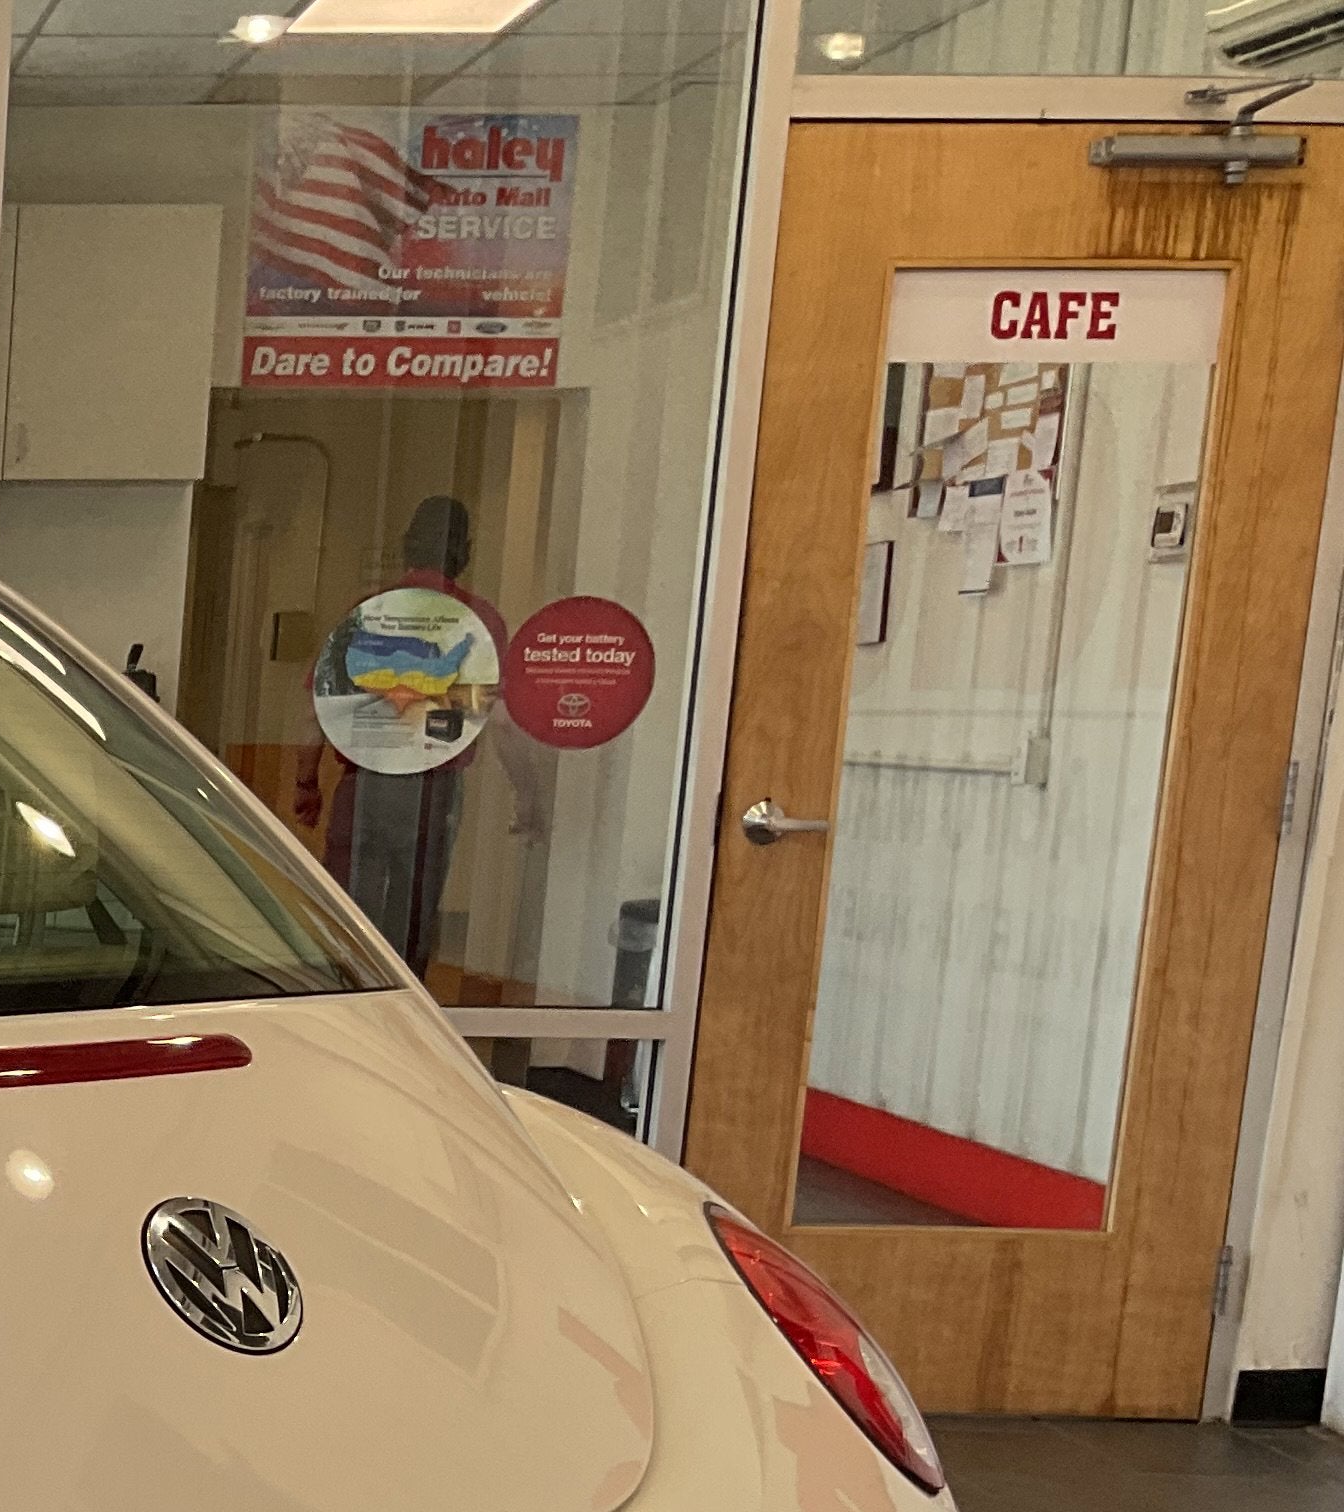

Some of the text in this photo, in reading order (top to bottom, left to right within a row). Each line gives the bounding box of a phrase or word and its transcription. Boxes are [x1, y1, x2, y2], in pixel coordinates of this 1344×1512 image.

[421, 125, 566, 182] haley
[496, 186, 552, 207] Mall
[416, 214, 557, 240] SERVICE
[378, 265, 410, 280] Our
[259, 286, 321, 303] factory
[390, 286, 421, 304] for
[990, 290, 1120, 340] CAFE
[250, 345, 553, 383] Dare to Compare!
[537, 632, 625, 646] Get your battery
[524, 647, 635, 667] tested today
[552, 718, 593, 728] TOYOTA
